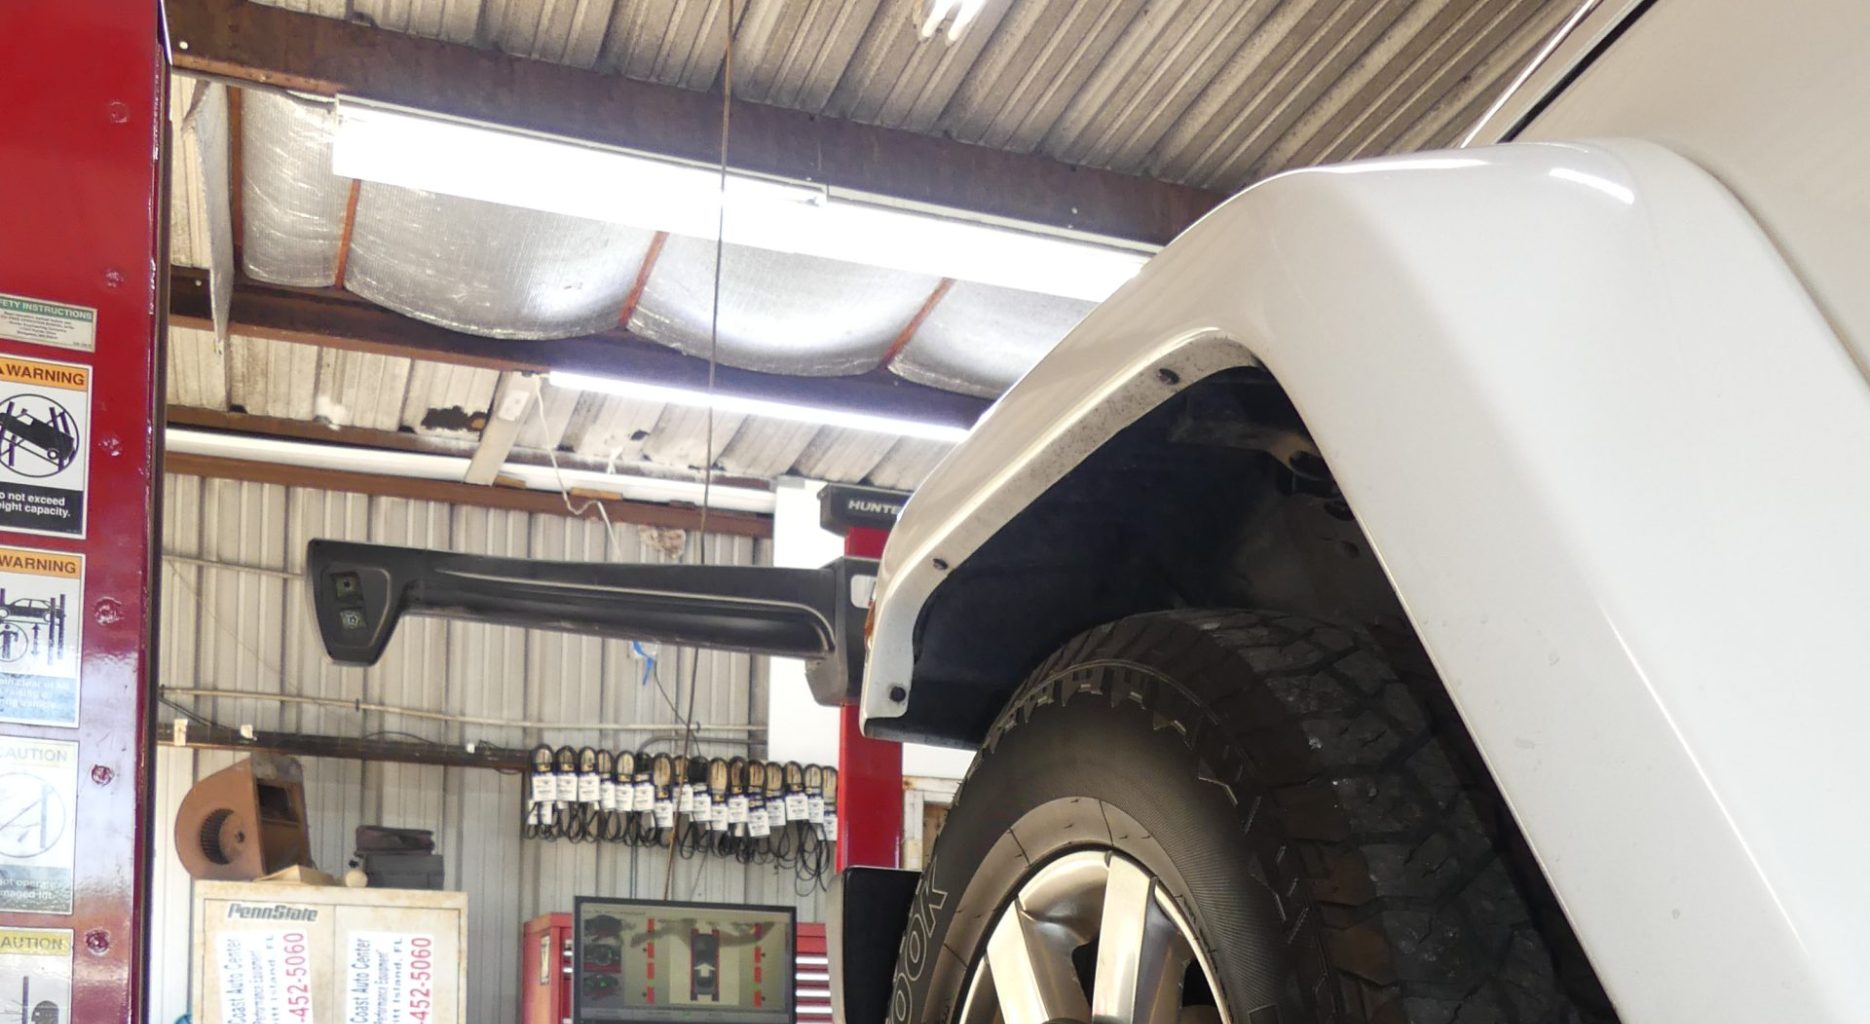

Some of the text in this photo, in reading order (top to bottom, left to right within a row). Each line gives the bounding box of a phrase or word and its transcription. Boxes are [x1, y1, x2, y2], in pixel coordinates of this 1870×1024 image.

[22, 303, 92, 319] INSTRUCTIONS
[6, 363, 85, 386] WARNING
[8, 492, 26, 502] not
[27, 495, 66, 506] exceed
[24, 505, 71, 518] capacity.
[228, 902, 318, 921] PennState
[351, 938, 370, 969] Center
[225, 973, 243, 994] Auto
[351, 973, 370, 994] Auto
[227, 998, 247, 1024] Coast
[349, 997, 369, 1023] Coast
